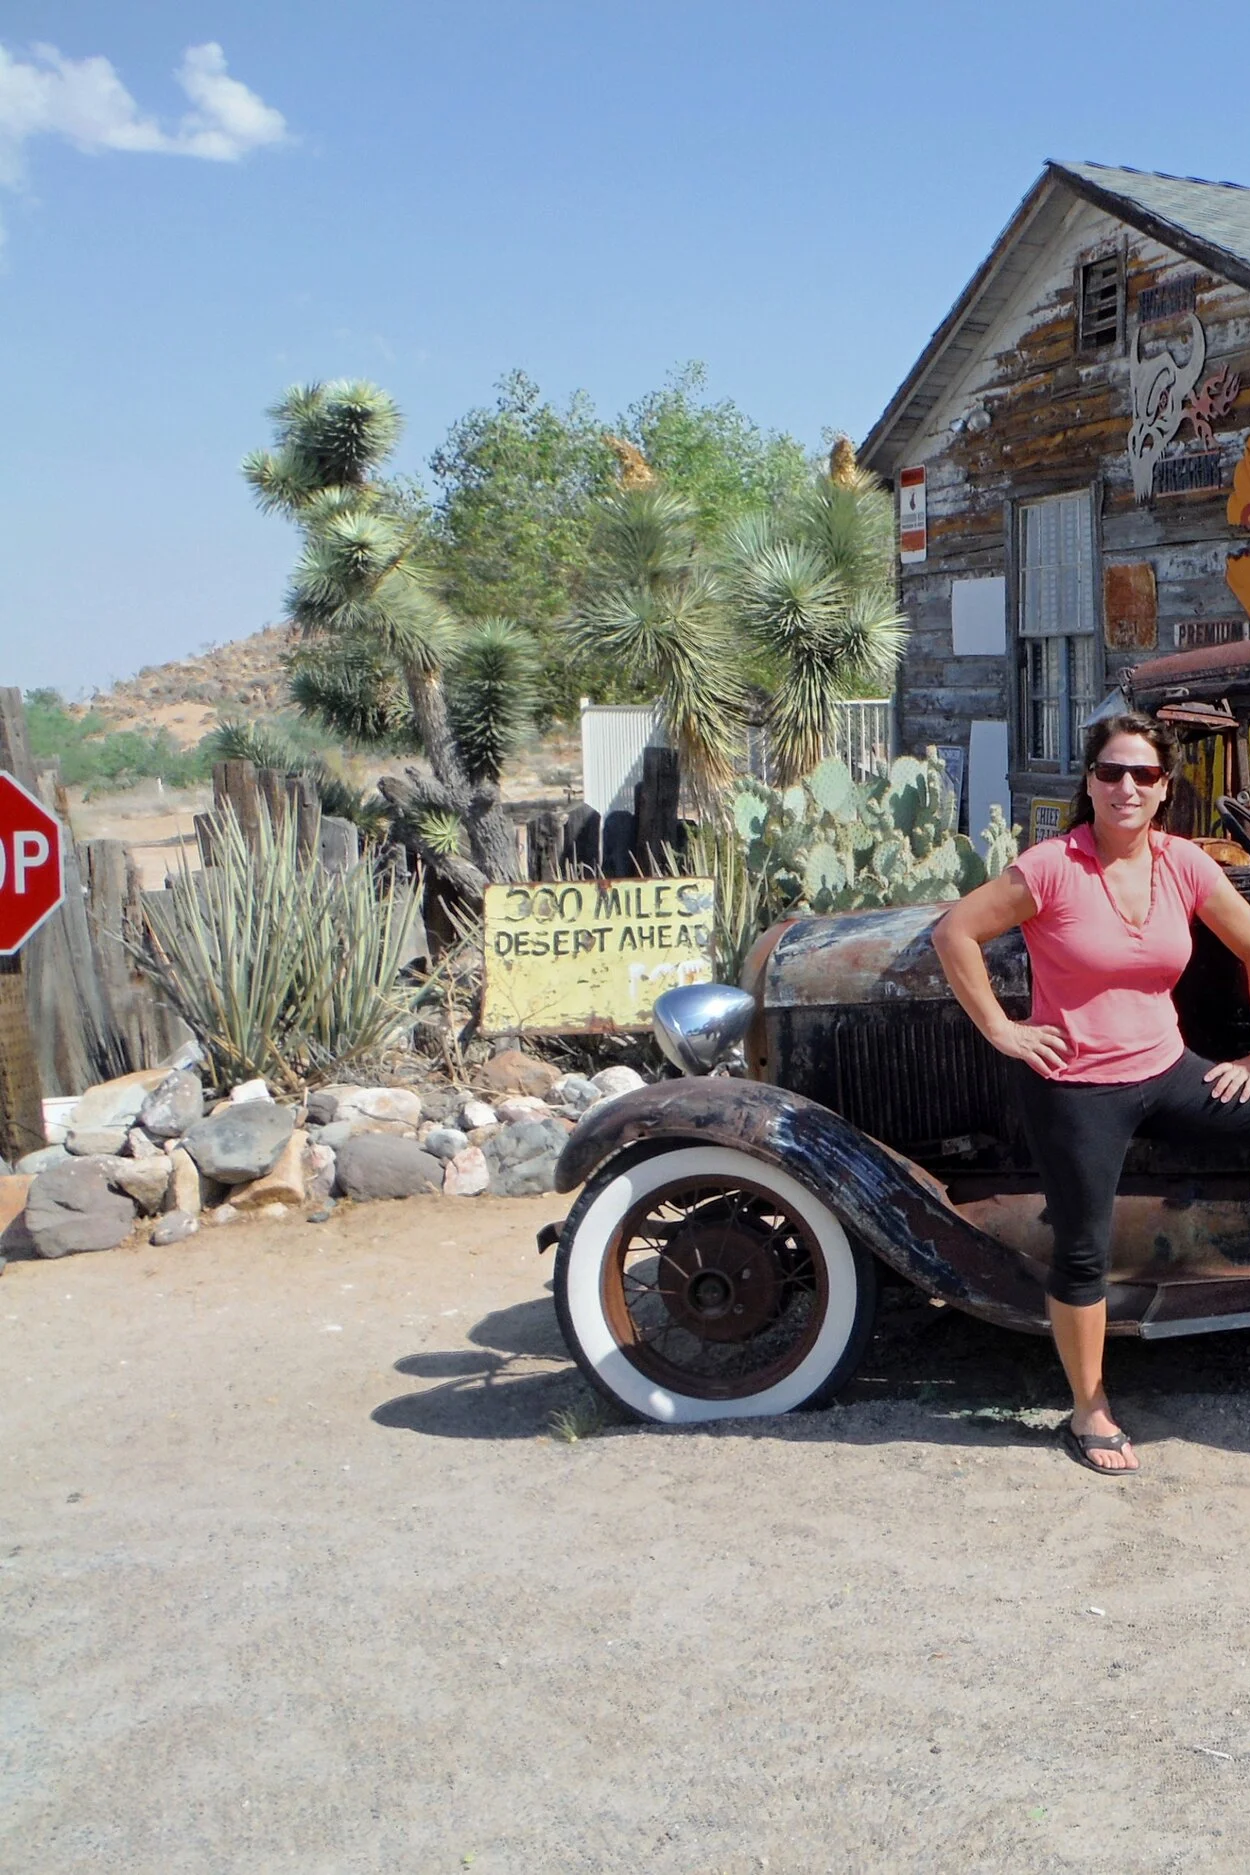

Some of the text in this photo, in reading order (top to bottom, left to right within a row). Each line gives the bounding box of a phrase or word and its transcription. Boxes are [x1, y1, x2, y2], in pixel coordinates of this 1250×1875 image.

[1179, 620, 1244, 648] PREMIUM
[505, 884, 701, 924] 300 MILES
[494, 923, 713, 959] DESERT AHEAD
